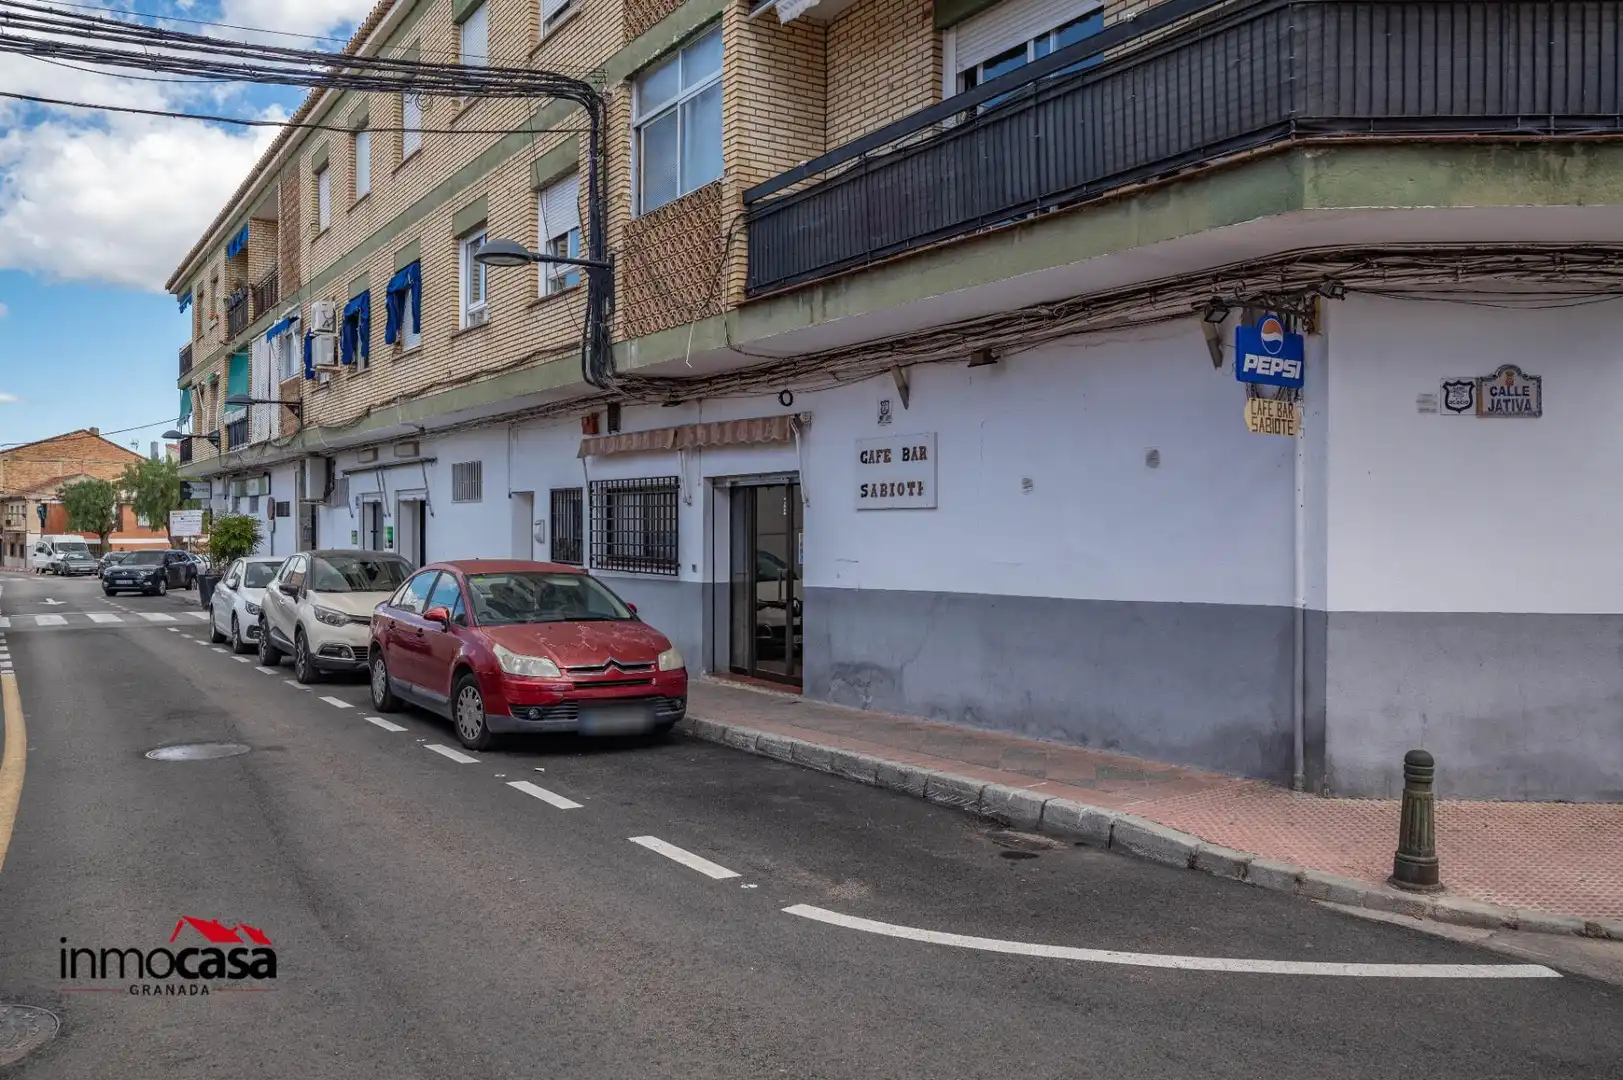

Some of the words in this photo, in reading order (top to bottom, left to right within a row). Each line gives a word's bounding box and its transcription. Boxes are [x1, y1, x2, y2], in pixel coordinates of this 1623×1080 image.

[1243, 353, 1302, 380] PEPSI
[1489, 385, 1530, 398] CALLE
[1250, 398, 1273, 417] CAFE
[1276, 400, 1294, 419] BAR
[1487, 399, 1533, 413] JATIVA
[1251, 416, 1294, 436] SABIOTE
[860, 448, 892, 465] CAFE
[902, 446, 928, 462] BAR
